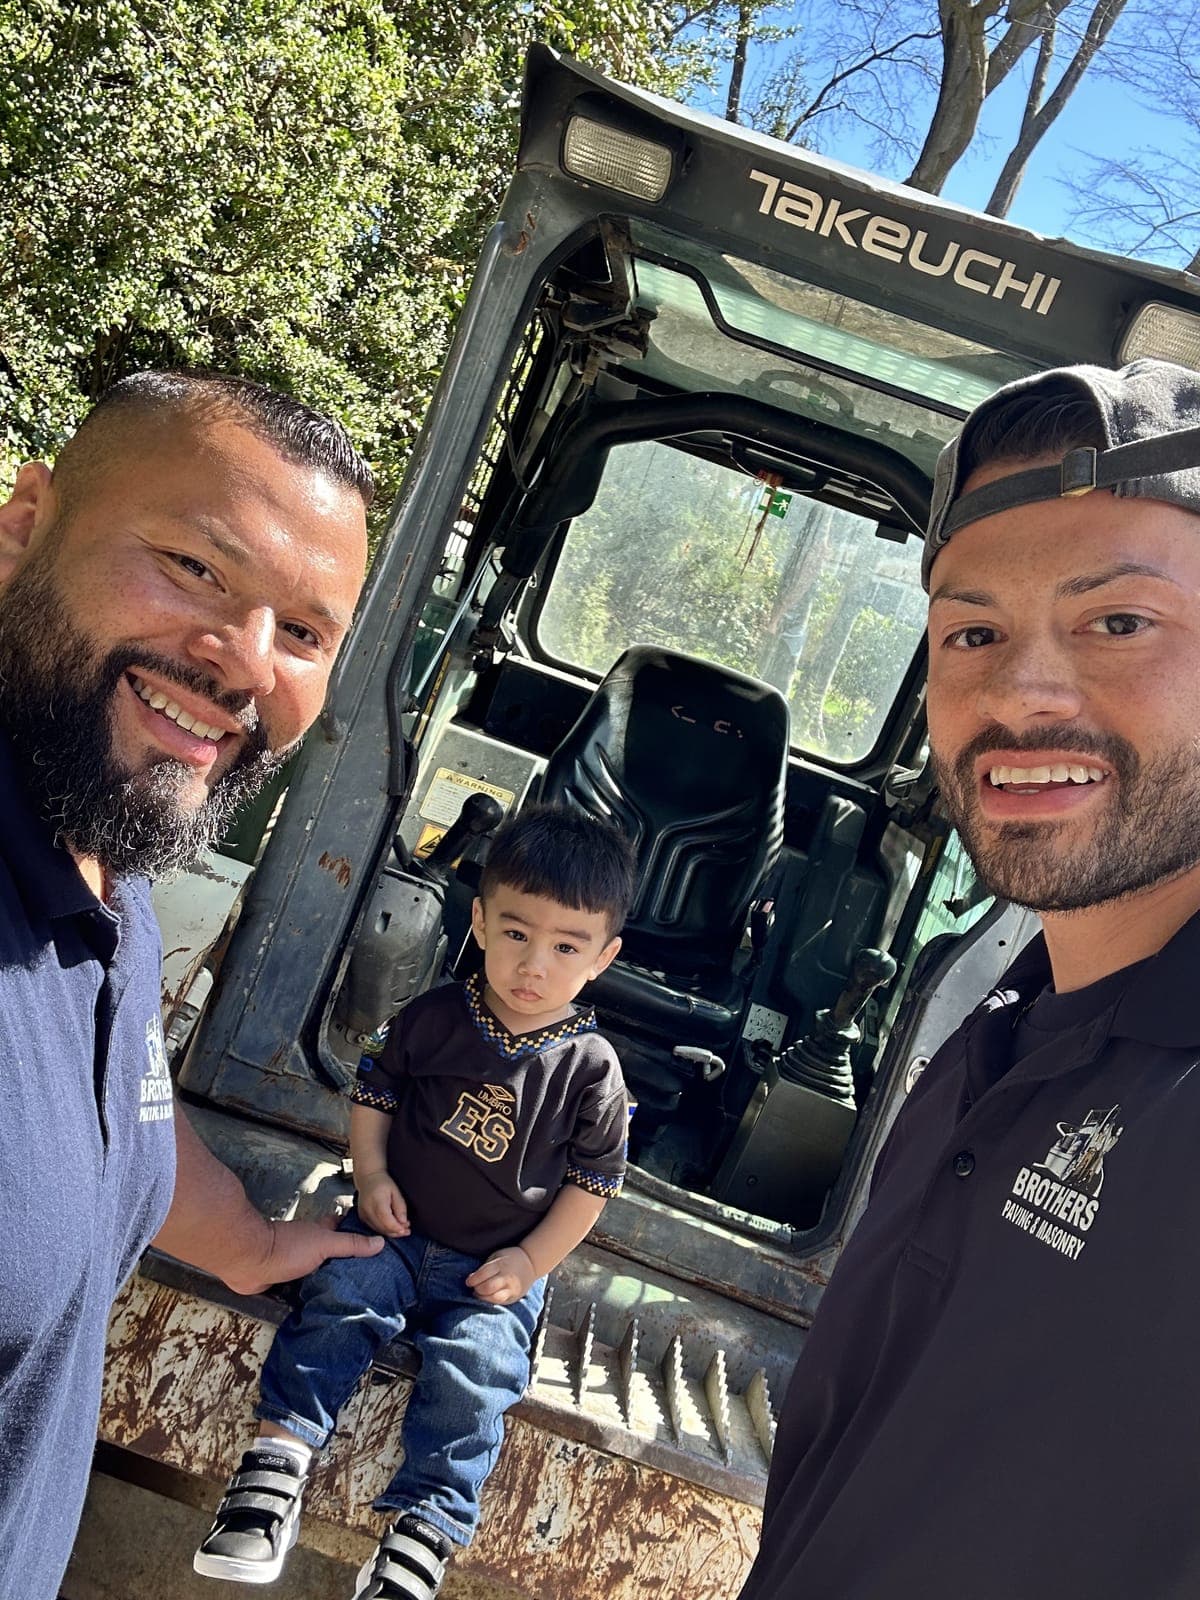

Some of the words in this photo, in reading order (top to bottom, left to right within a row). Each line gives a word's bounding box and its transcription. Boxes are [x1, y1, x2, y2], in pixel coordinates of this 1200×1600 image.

[455, 777, 504, 798] WARNING
[439, 1091, 516, 1163] ES
[477, 1089, 513, 1116] UMBRO
[1001, 1199, 1035, 1232] PAVING
[1029, 1216, 1041, 1235] &
[1035, 1219, 1086, 1261] MASONRY
[1012, 1166, 1100, 1232] BROTHERS
